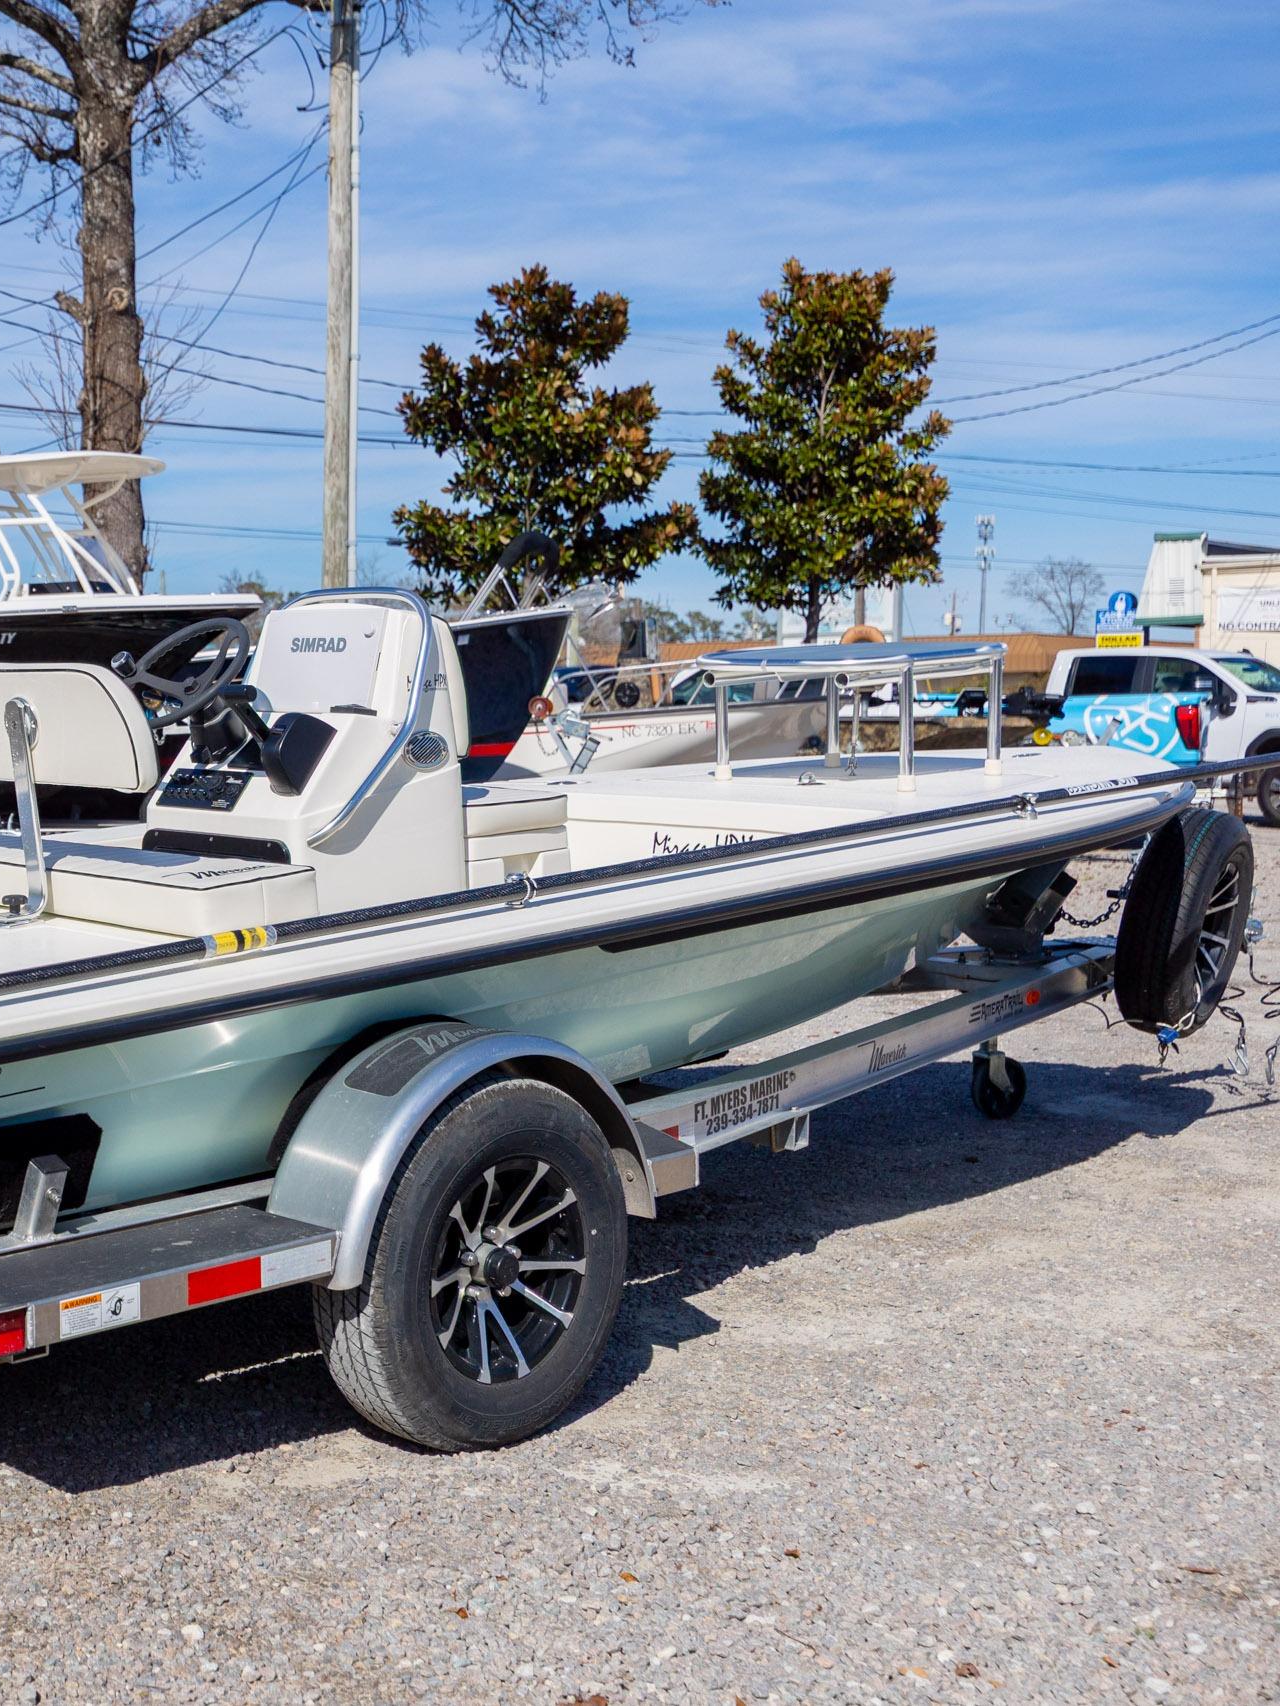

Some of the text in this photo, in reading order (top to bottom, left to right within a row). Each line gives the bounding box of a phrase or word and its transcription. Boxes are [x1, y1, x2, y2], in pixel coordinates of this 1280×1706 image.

[0, 631, 17, 645] TY
[290, 637, 348, 653] SIMRAD
[621, 725, 642, 738] NC
[646, 724, 673, 738] 7320
[678, 722, 698, 735] EK
[693, 1071, 790, 1124] FT. MYERS MARINE
[706, 1093, 780, 1137] 239-334-7871
[68, 1295, 99, 1309] WARNING
